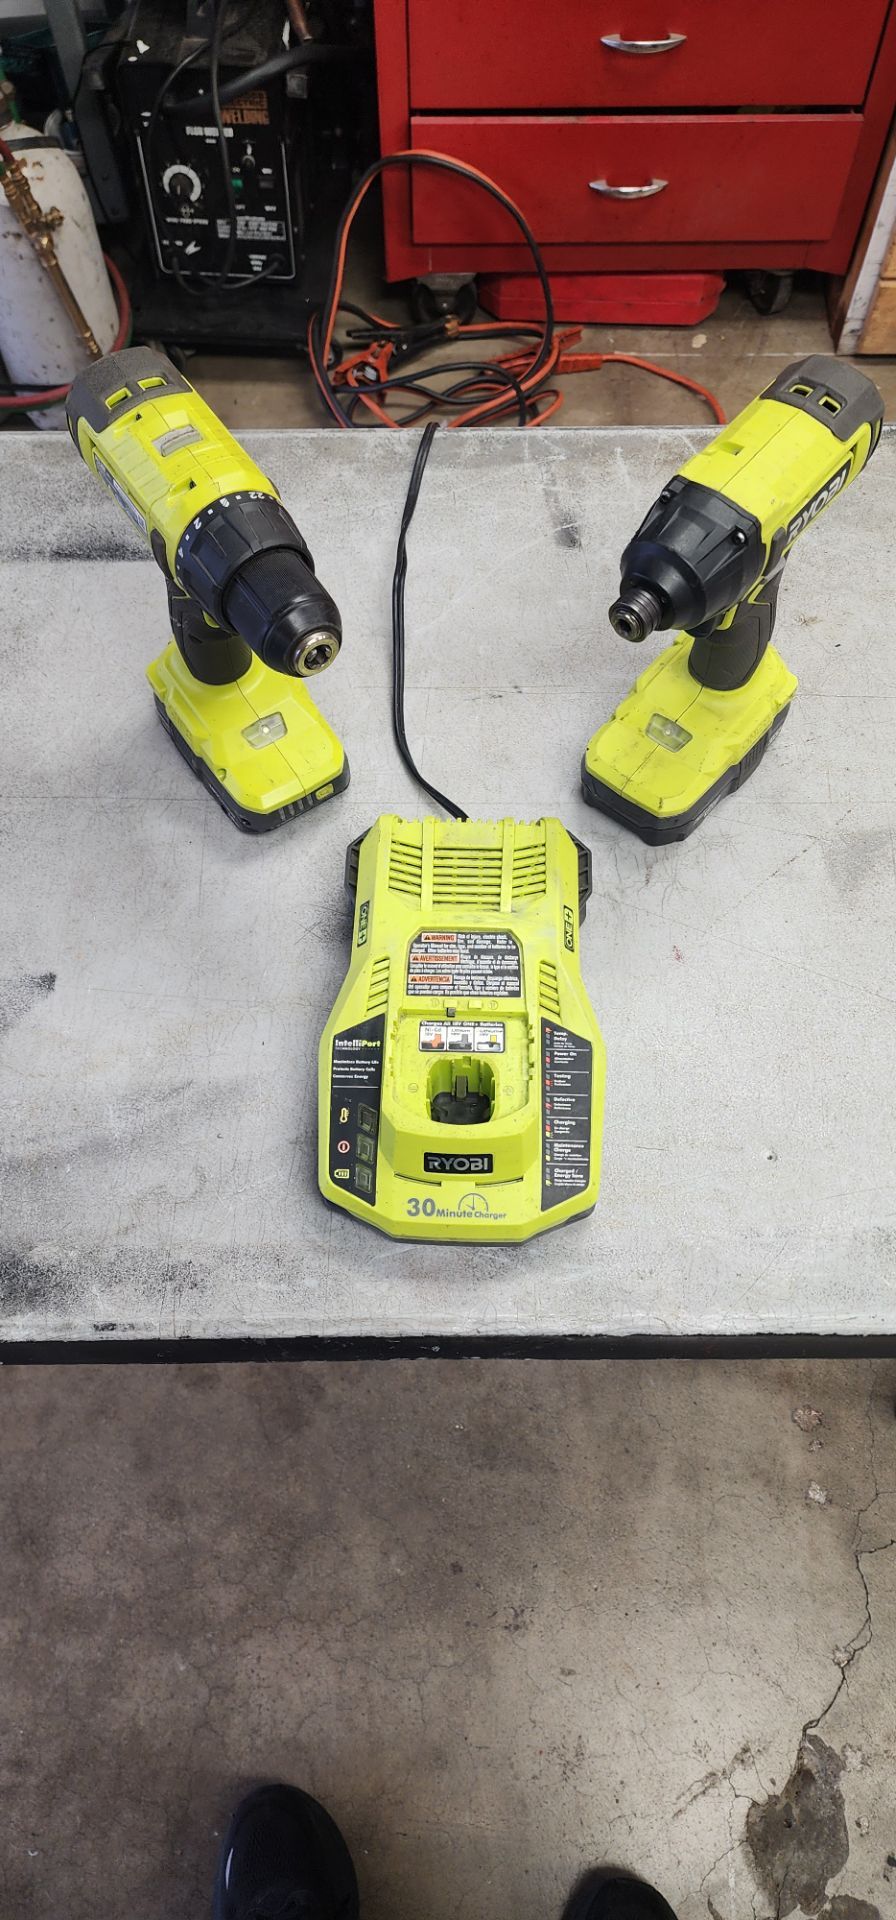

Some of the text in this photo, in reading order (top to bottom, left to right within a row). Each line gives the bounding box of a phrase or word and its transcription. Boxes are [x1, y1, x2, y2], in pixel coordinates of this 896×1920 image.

[787, 468, 847, 544] RYOBI
[335, 1039, 381, 1047] IntelliPort
[427, 1156, 489, 1171] RYOBI
[406, 1197, 507, 1220] 30 Minute Charger
